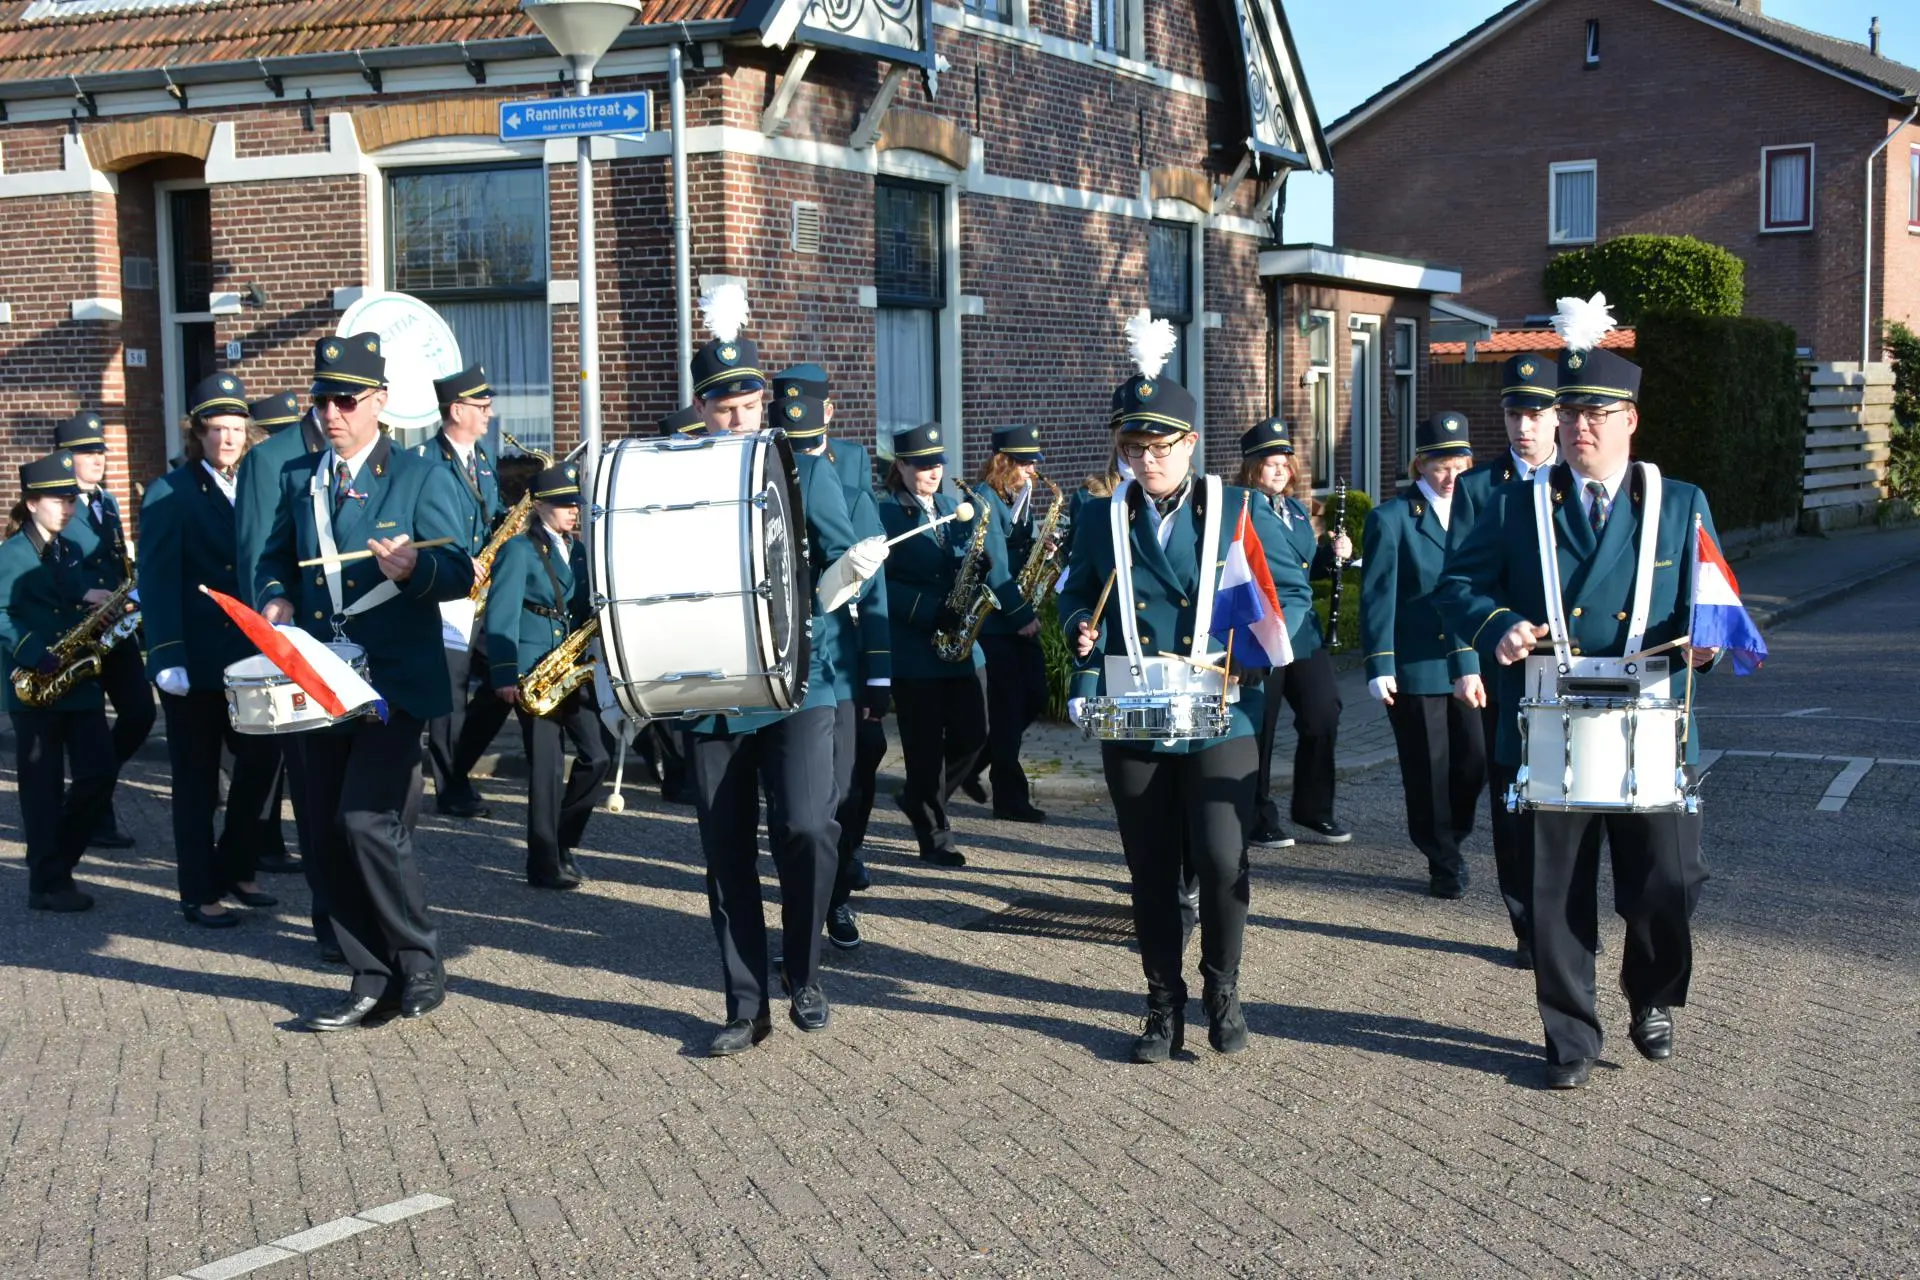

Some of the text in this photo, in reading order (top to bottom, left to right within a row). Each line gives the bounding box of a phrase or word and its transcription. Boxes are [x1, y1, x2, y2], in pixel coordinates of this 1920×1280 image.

[525, 101, 621, 122] Ranninkstraat
[380, 313, 420, 344] CITIA
[227, 342, 240, 358] 50
